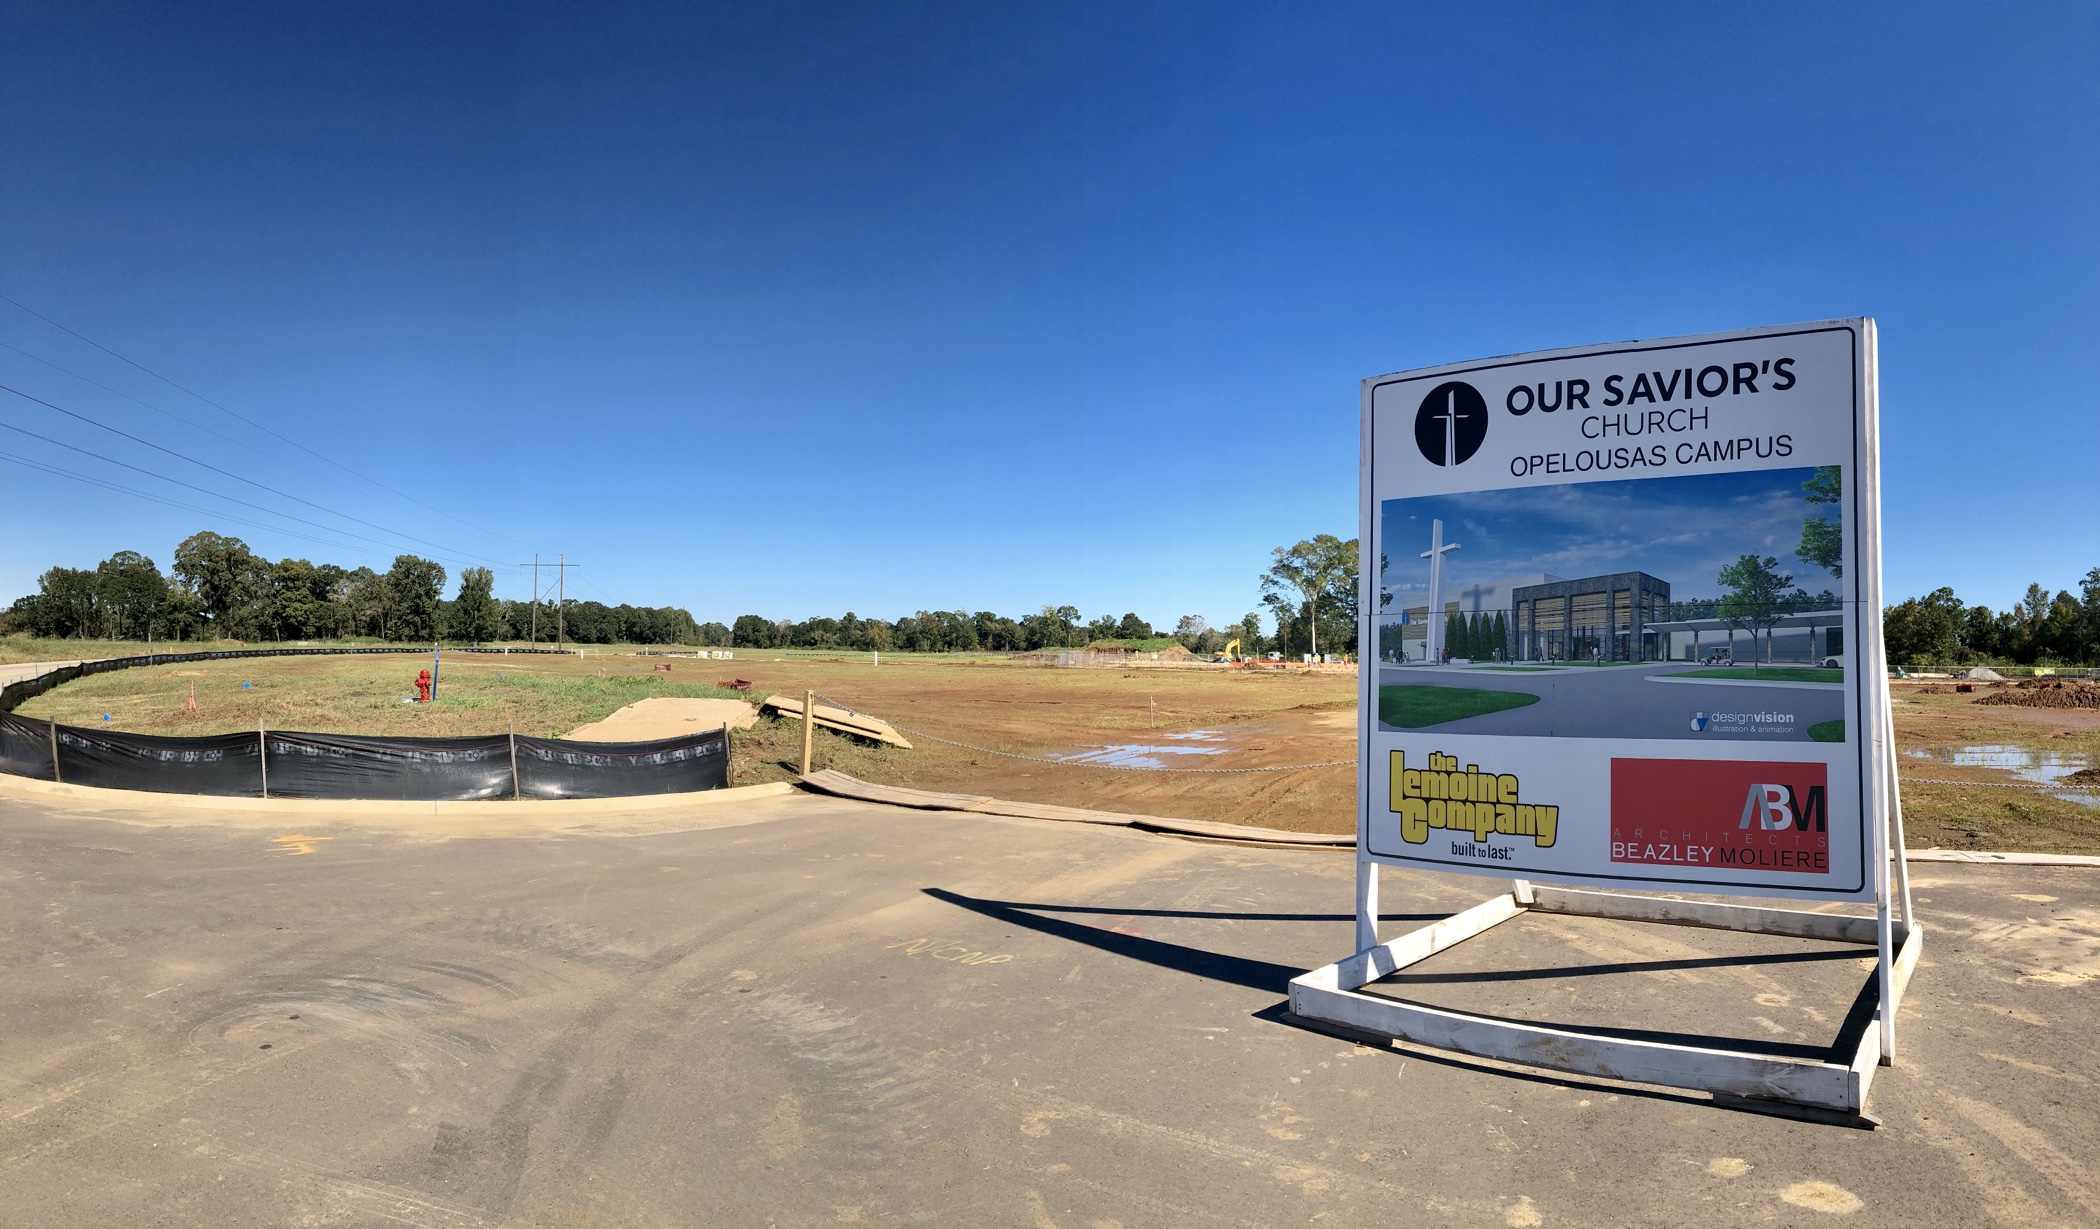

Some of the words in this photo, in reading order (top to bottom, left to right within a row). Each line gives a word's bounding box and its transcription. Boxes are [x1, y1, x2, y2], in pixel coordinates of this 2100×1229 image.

[1506, 378, 1591, 416] OUR
[1602, 357, 1797, 407] SAVIOR'S
[1581, 406, 1709, 439] CHURCH
[1510, 445, 1667, 477] OPELOUSAS
[1675, 434, 1793, 464] CAMPUS
[1712, 725, 1749, 733] illustration
[1750, 725, 1756, 733] &
[1758, 726, 1794, 734] animation
[1428, 751, 1458, 772] the
[1738, 783, 1826, 833] ABM
[1451, 840, 1476, 857] built
[1478, 847, 1487, 858] to
[1613, 827, 1827, 848] ARCHITECTS
[1612, 842, 1715, 863] BEAZLEY
[1720, 847, 1827, 869] MOLIERE
